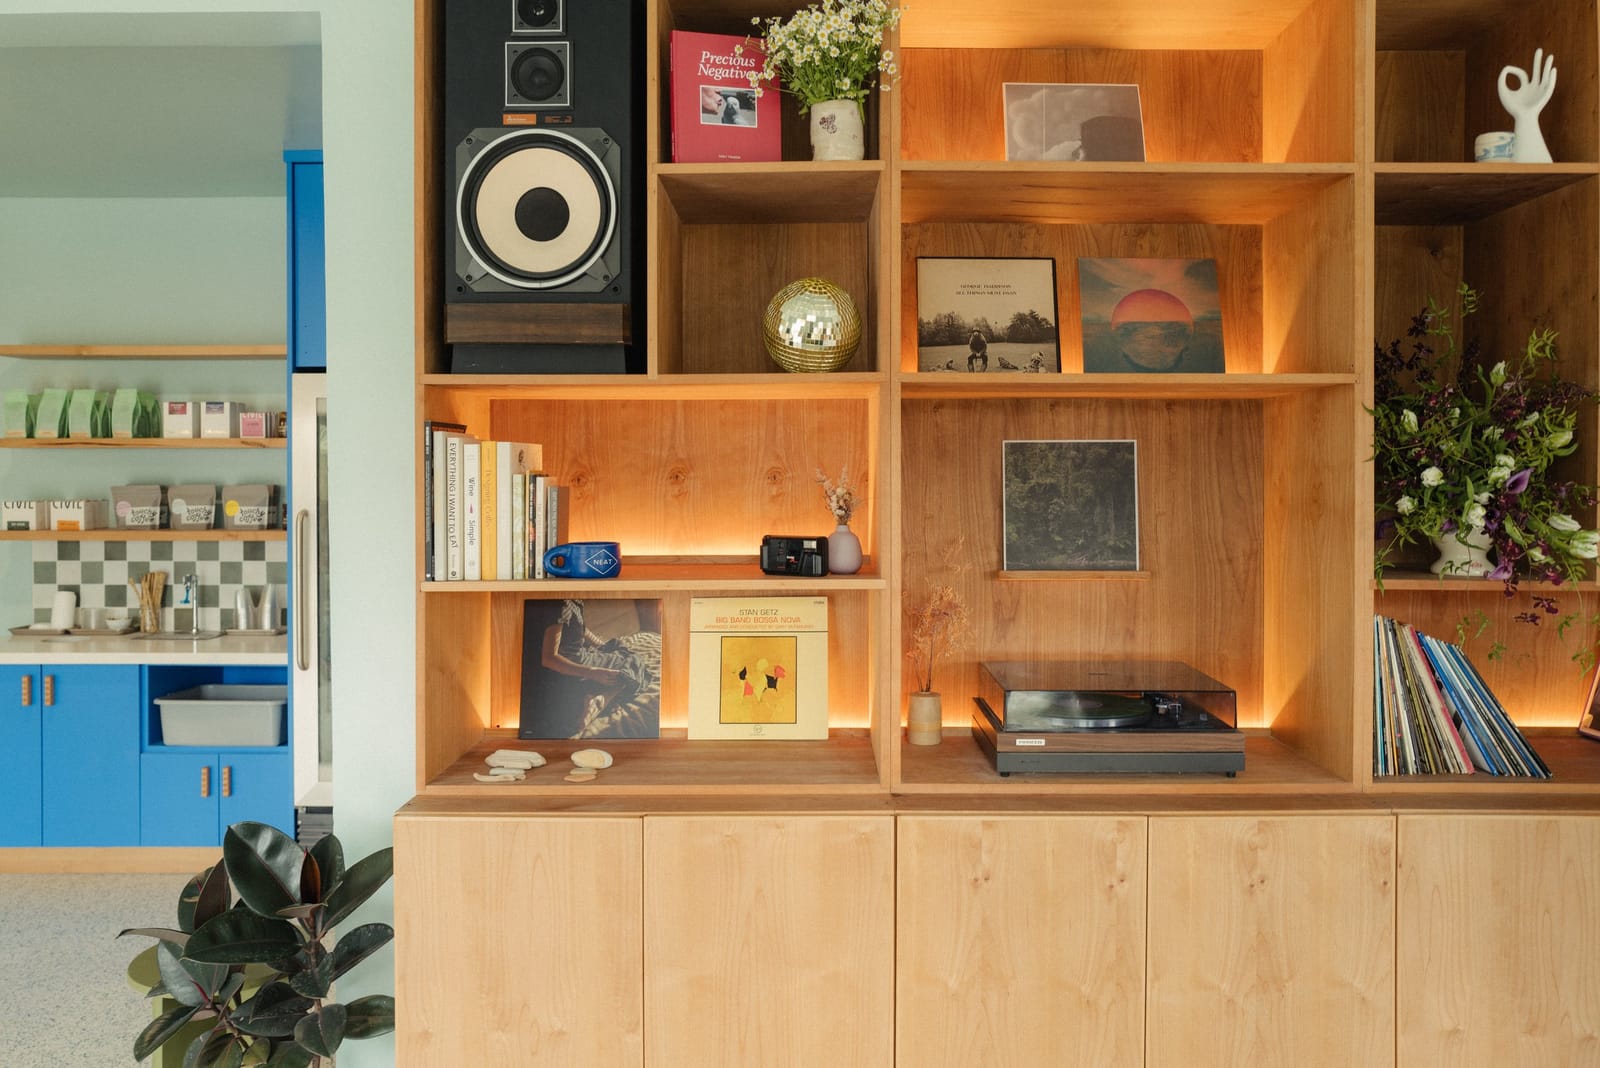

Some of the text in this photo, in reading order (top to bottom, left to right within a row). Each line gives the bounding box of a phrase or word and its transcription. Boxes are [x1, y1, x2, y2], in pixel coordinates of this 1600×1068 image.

[701, 50, 755, 67] Precious
[448, 442, 457, 492] EVERYTHING
[466, 477, 476, 496] Wine
[448, 498, 456, 522] WANT
[448, 524, 456, 534] TO
[466, 520, 477, 546] Simple
[449, 536, 458, 548] EAT
[715, 616, 801, 624] BIG BAND BOSSA NOVA
